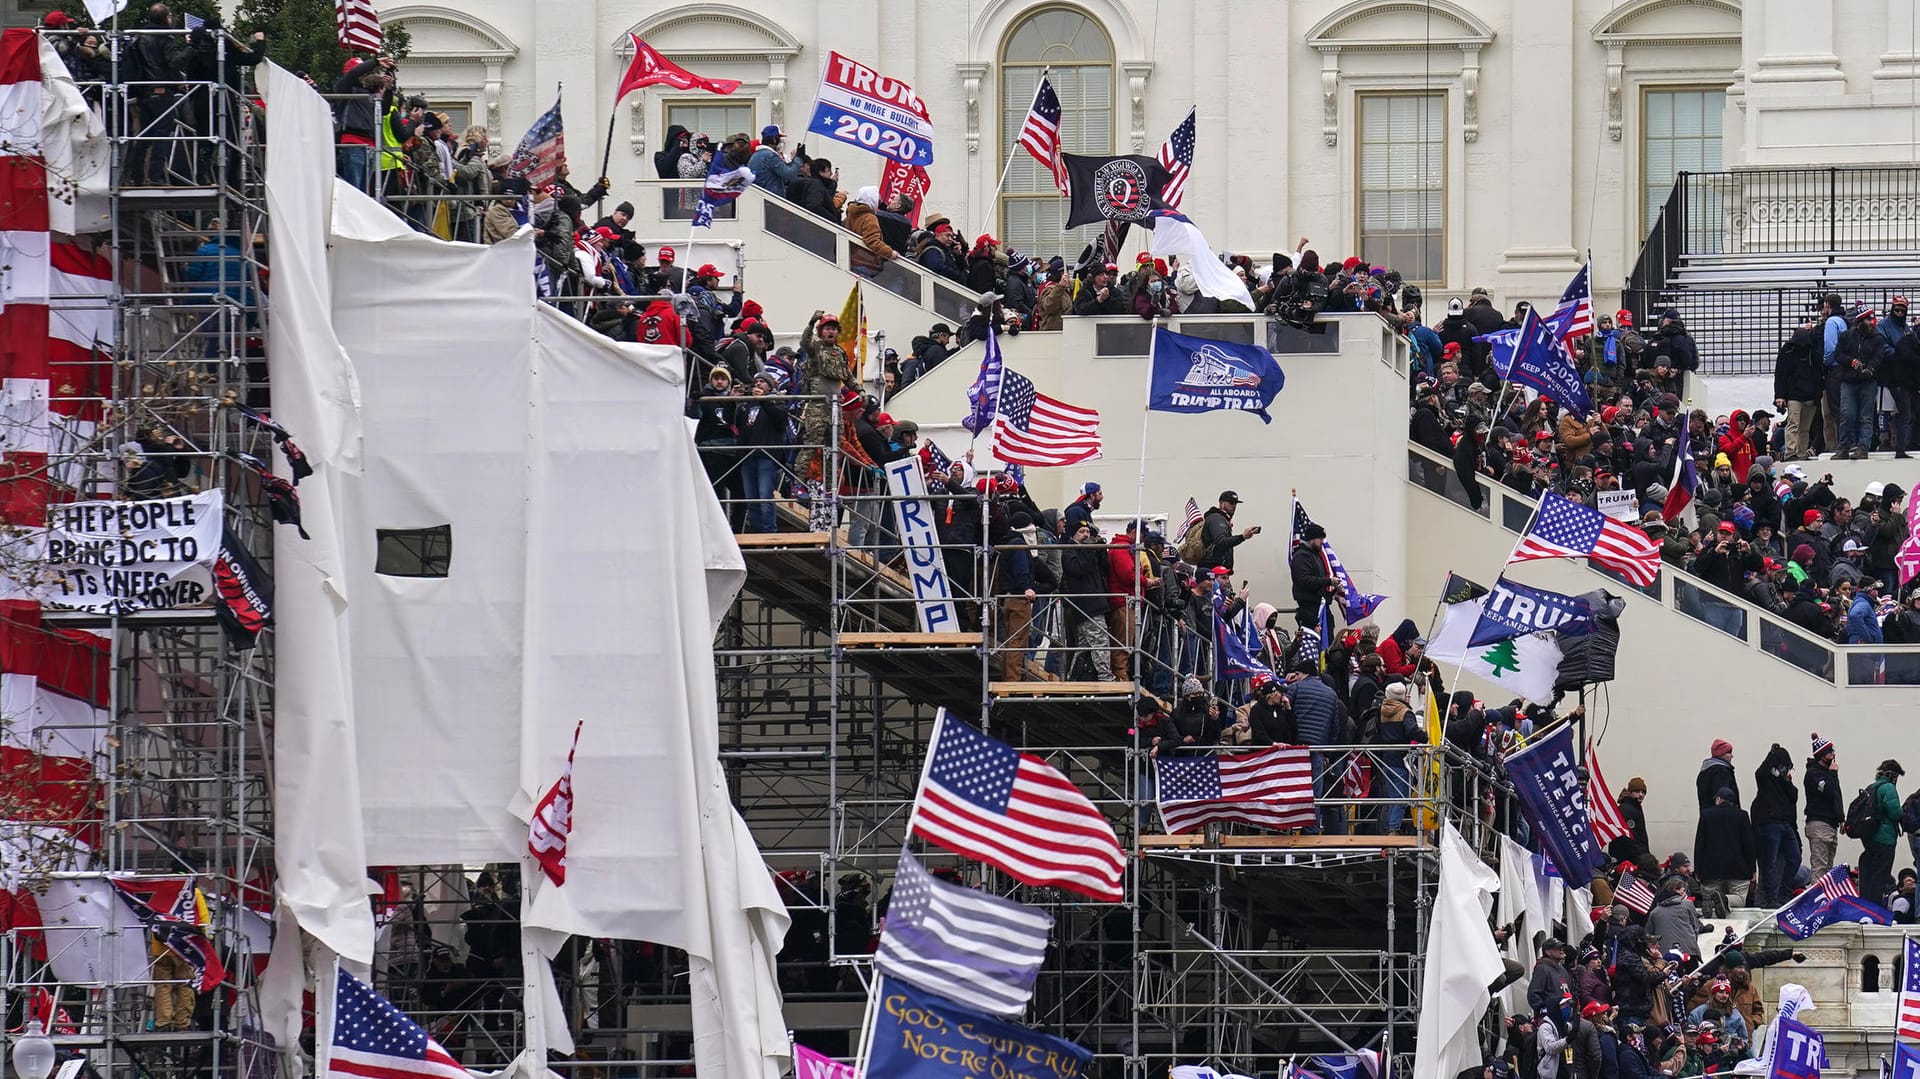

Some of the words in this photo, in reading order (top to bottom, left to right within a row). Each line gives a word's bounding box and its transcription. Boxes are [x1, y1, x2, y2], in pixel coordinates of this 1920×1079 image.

[850, 97, 861, 108] NO
[863, 102, 886, 117] MORE
[834, 114, 917, 160] 2020
[1109, 178, 1131, 209] Q
[1520, 362, 1541, 373] KEEP
[1171, 393, 1222, 408] TRUMP
[1210, 389, 1223, 397] ALL
[1599, 493, 1635, 505] TRUMP
[102, 499, 196, 532] PEOPLE
[120, 539, 155, 567] DC
[161, 536, 199, 562] TO
[892, 464, 948, 634] TRUMP
[230, 563, 268, 614] OWNERS
[1534, 774, 1547, 793] MAKE
[1543, 791, 1560, 819] AMERICA
[1558, 817, 1571, 838] GREAT
[1543, 770, 1590, 853] PENCE
